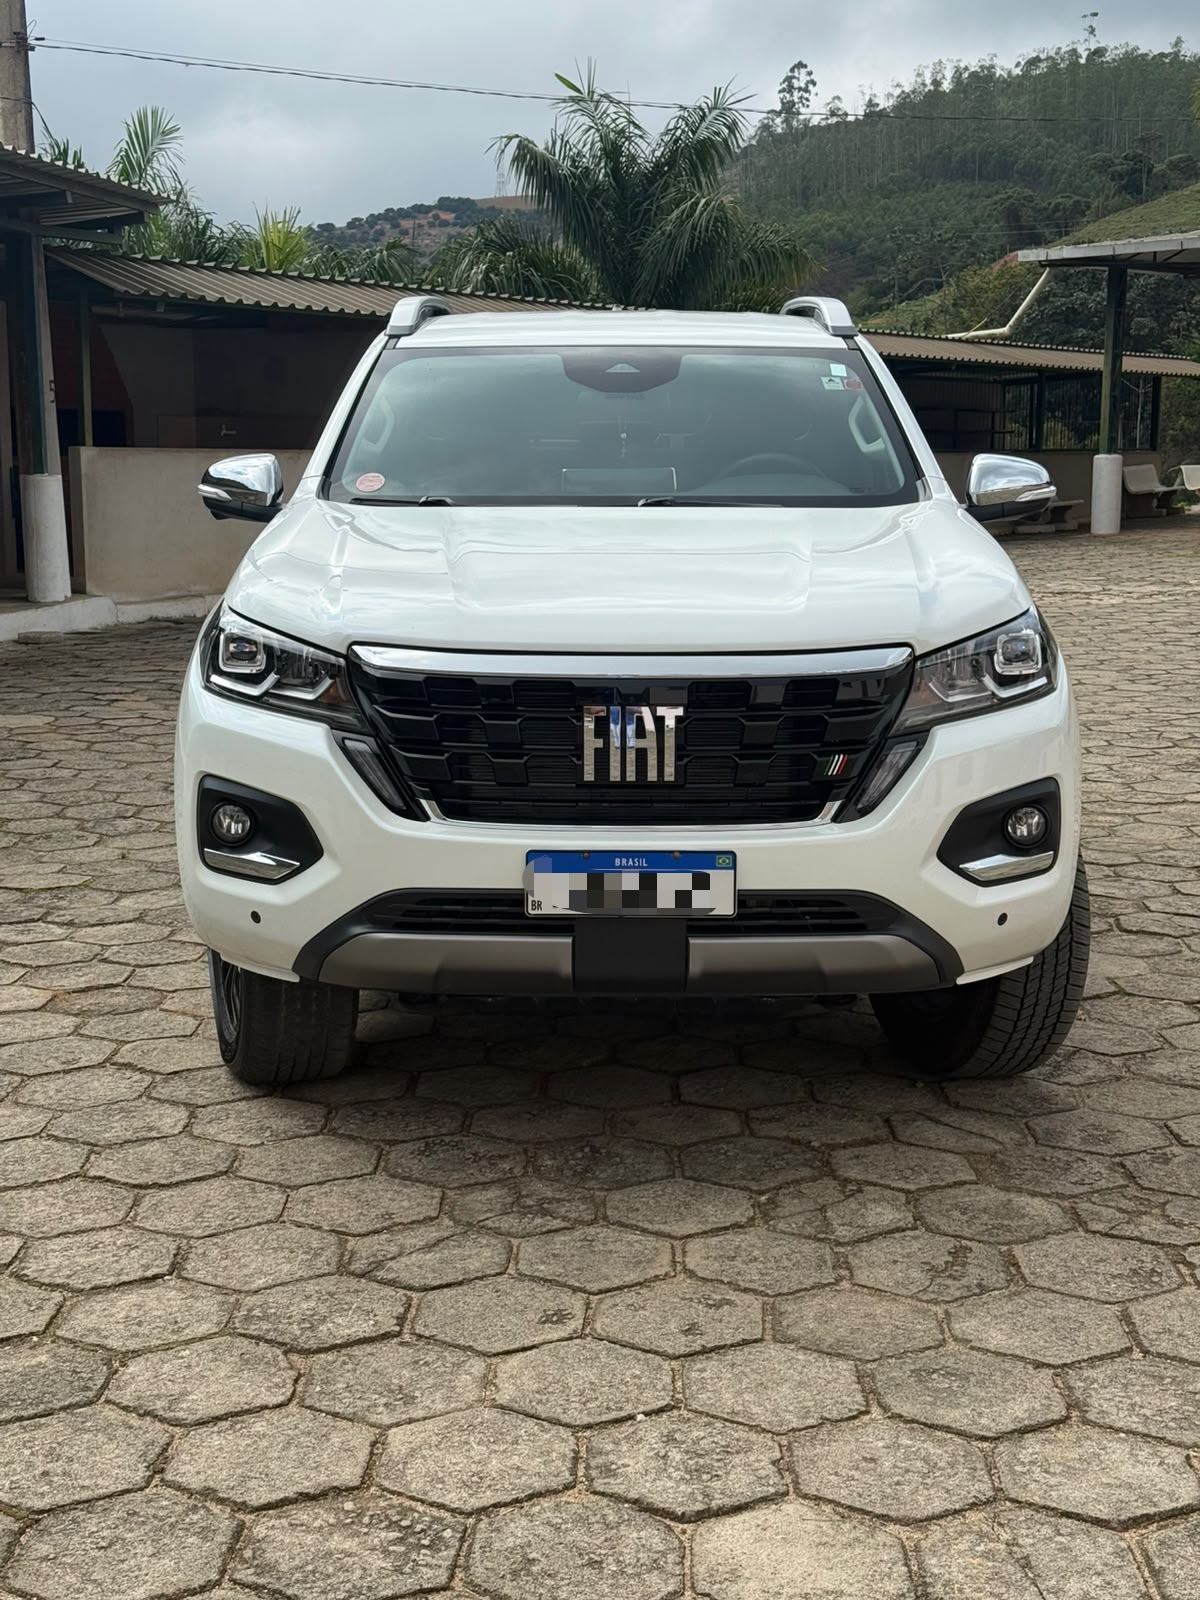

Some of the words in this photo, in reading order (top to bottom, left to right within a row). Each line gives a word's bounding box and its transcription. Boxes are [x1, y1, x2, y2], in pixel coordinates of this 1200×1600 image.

[583, 705, 684, 782] FIAT
[614, 857, 648, 867] BRASIL
[530, 900, 543, 911] BR
